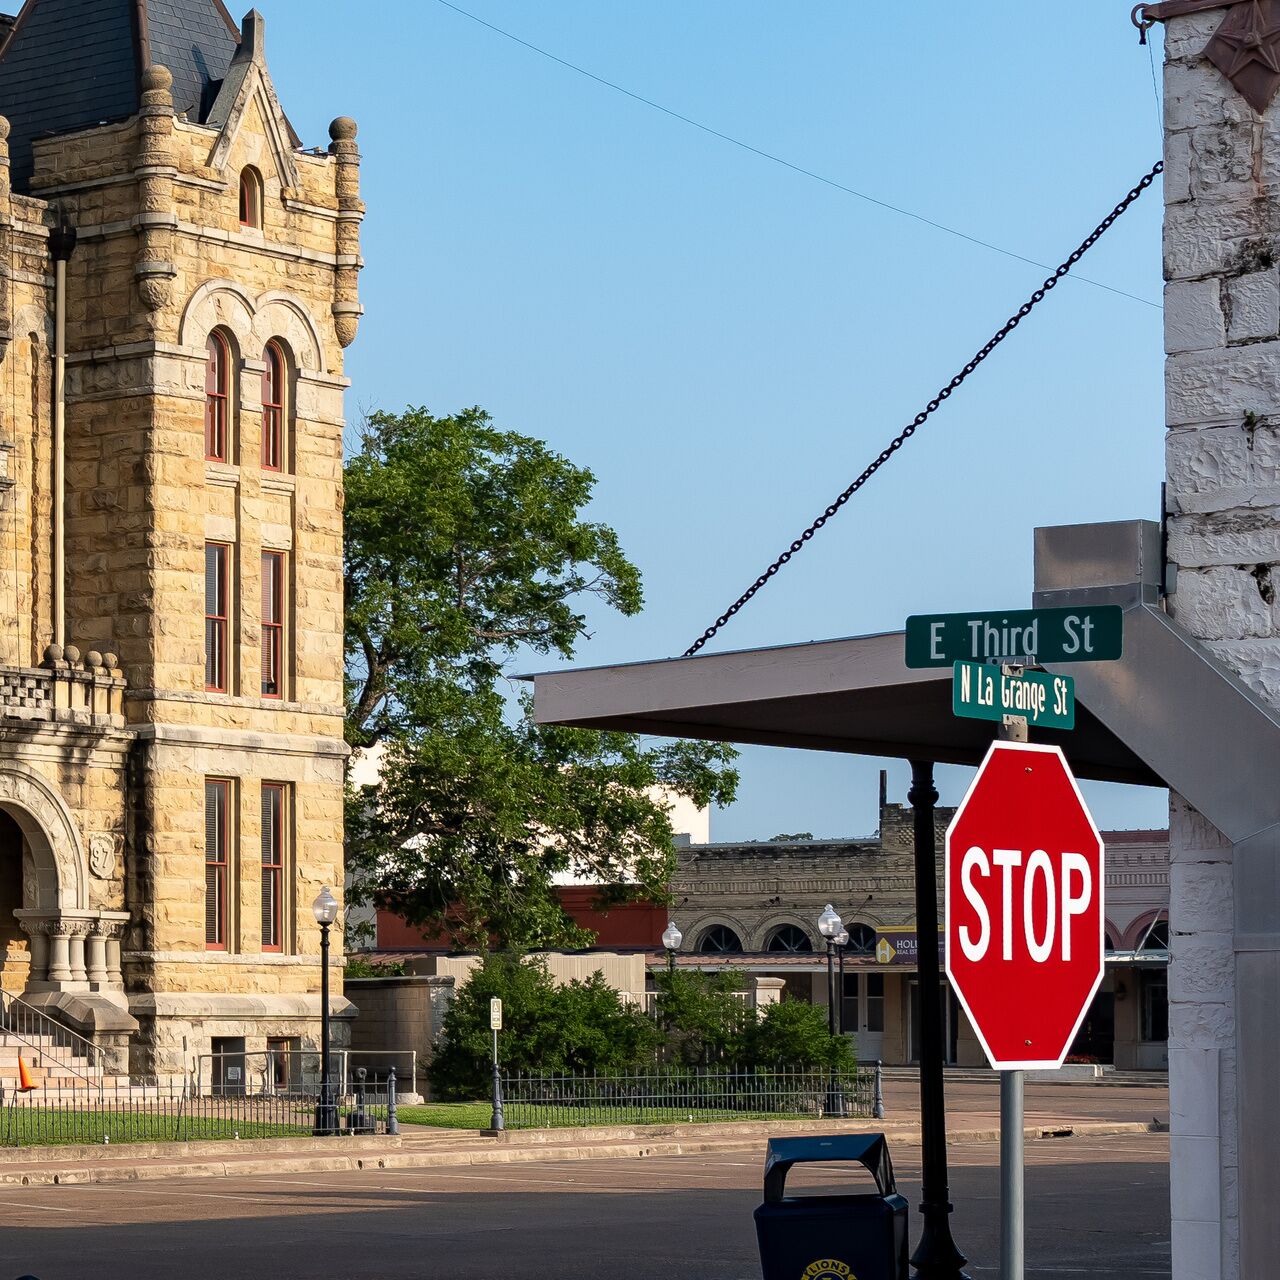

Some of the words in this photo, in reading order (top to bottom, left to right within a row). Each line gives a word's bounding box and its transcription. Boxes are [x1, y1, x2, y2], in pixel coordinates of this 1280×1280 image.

[930, 622, 945, 660] E
[968, 618, 1037, 657] Third
[1062, 616, 1094, 653] St
[961, 664, 971, 703] N
[978, 667, 993, 706] La
[1001, 676, 1046, 721] Grange
[1053, 677, 1068, 716] St
[958, 846, 1092, 963] STOP
[808, 1261, 848, 1274] LIONS
